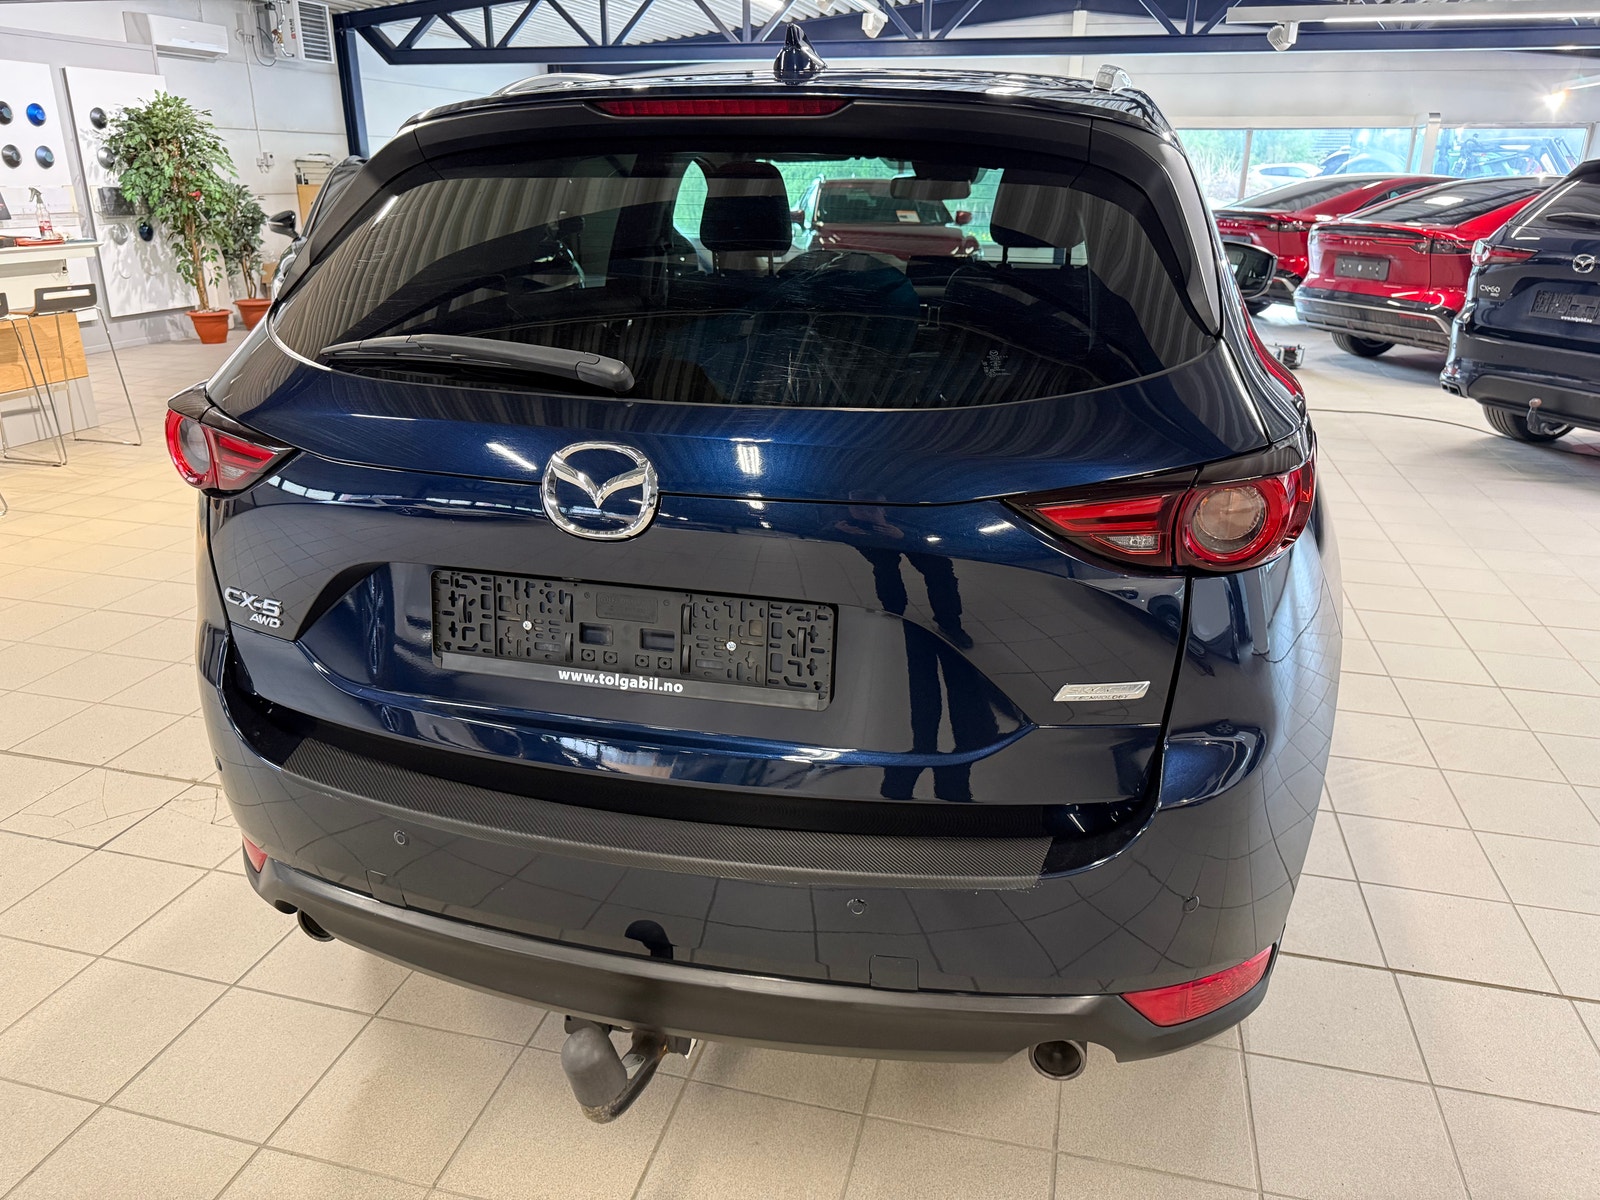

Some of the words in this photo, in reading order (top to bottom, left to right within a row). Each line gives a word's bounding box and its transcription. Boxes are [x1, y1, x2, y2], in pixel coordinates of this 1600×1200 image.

[224, 586, 283, 617] CX-5
[249, 614, 281, 628] AWD
[558, 670, 684, 693] www.tolgabil.no
